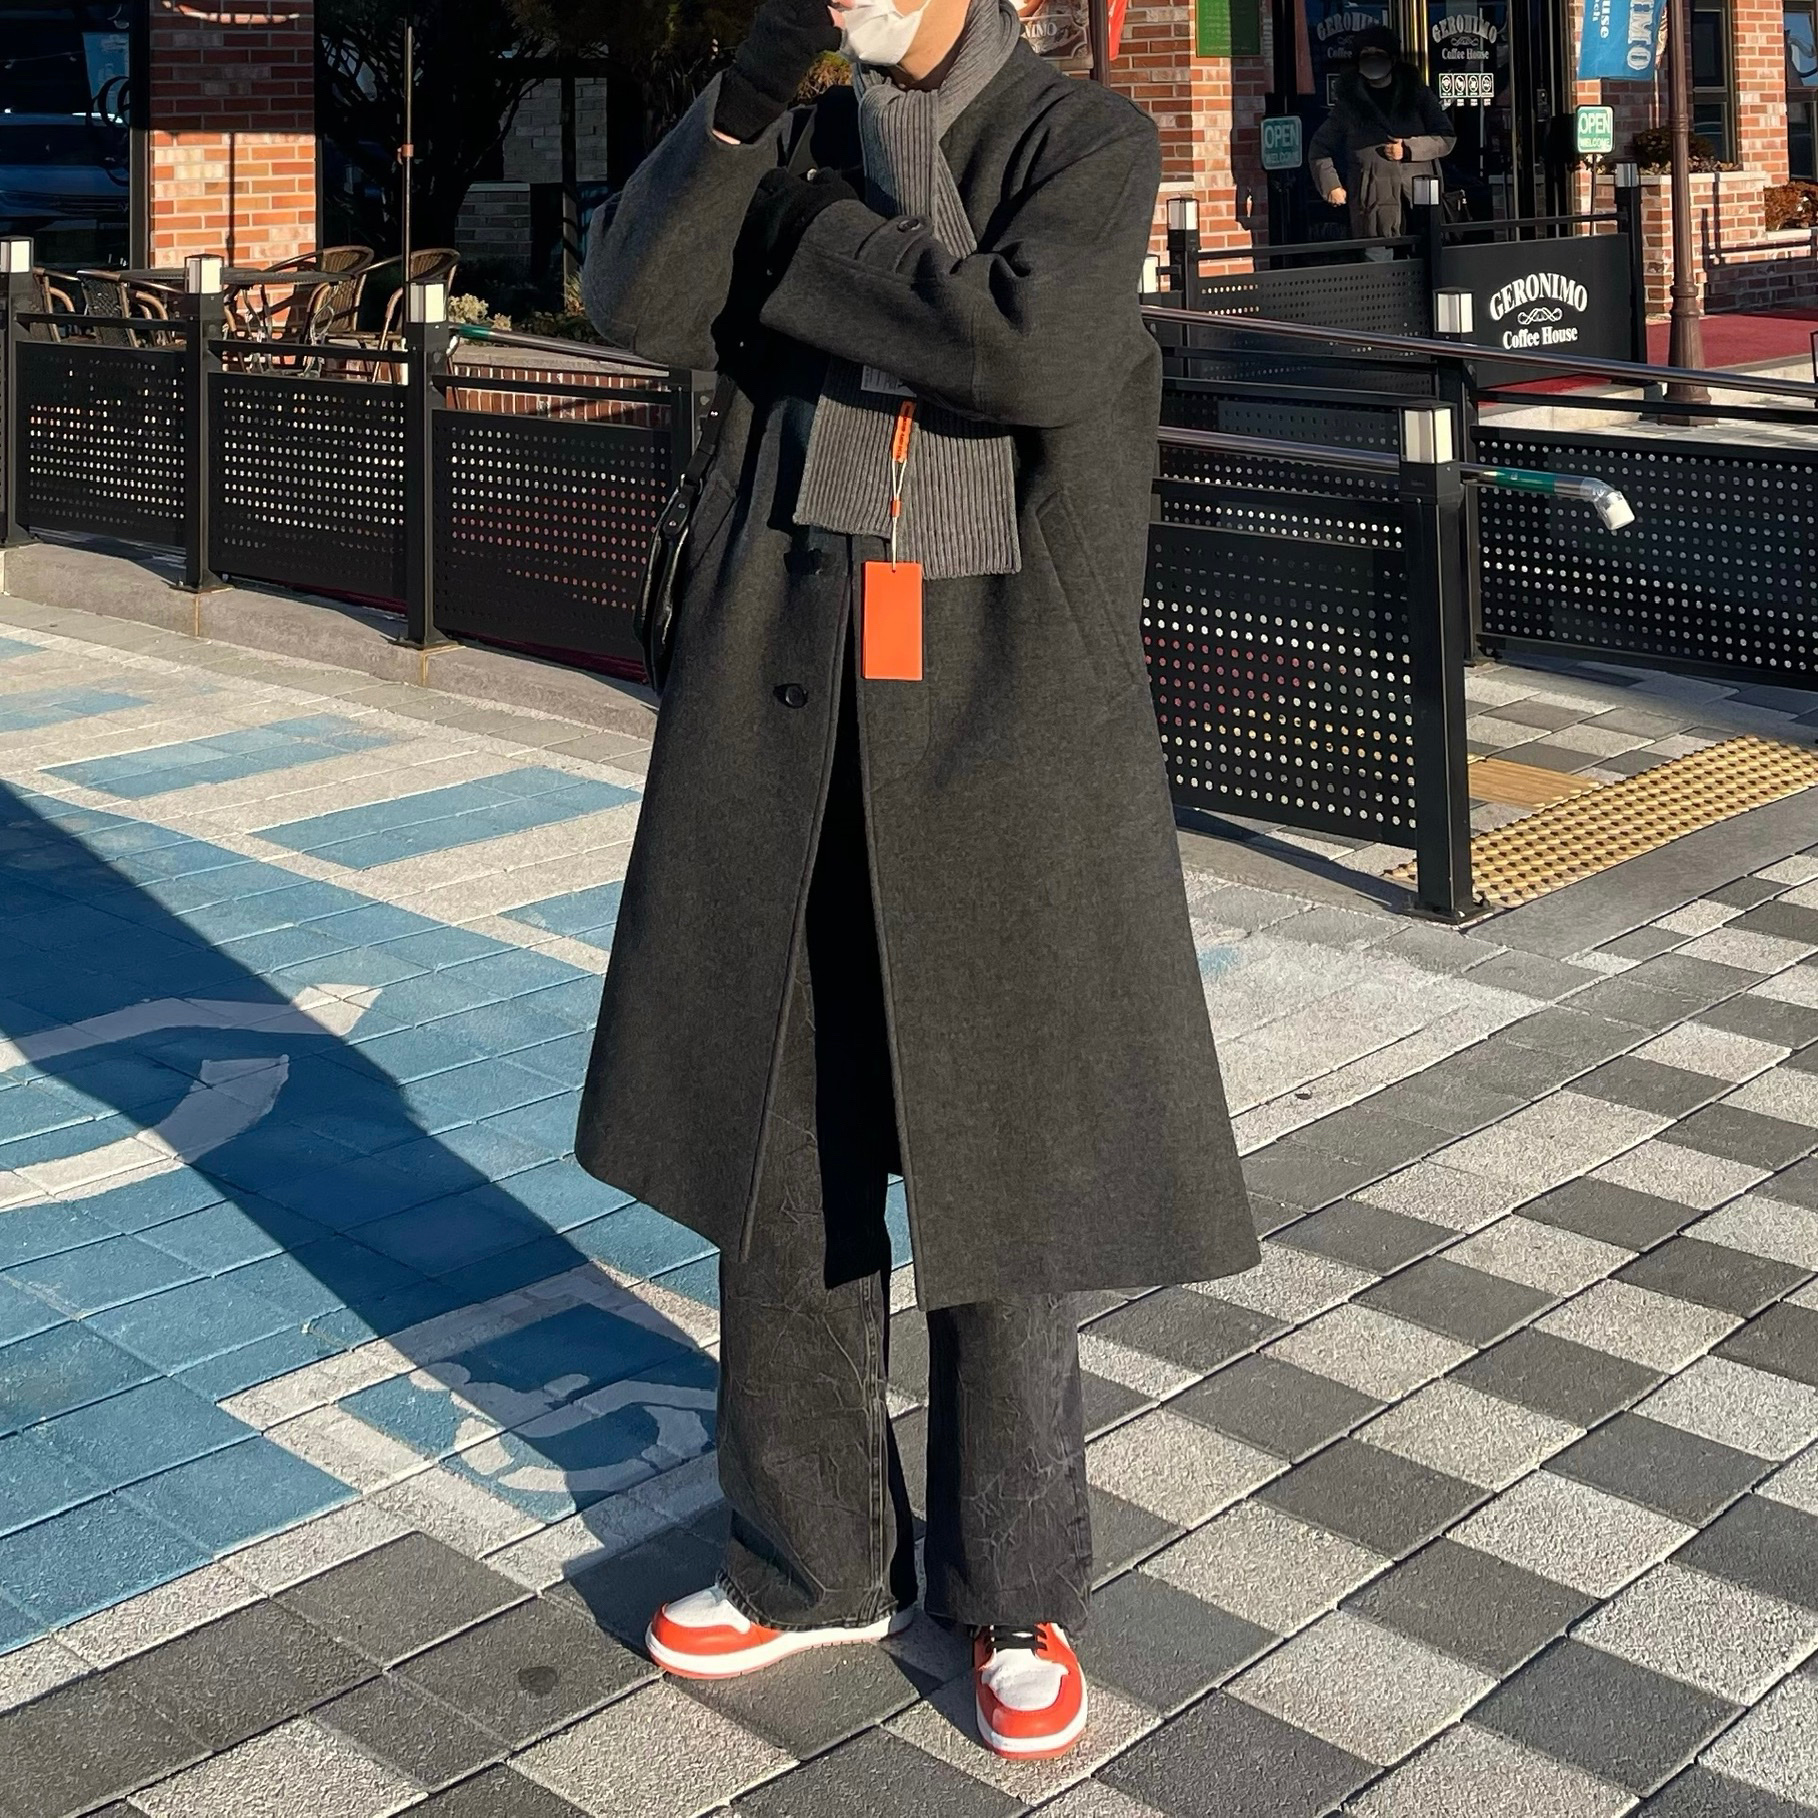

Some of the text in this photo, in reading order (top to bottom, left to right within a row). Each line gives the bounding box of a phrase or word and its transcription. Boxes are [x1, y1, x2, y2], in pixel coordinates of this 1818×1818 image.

[1432, 14, 1498, 44] GERONIMO
[1441, 47, 1490, 60] Coffee House
[1580, 112, 1612, 134] OPEN
[1265, 124, 1300, 149] OPEN
[1489, 271, 1588, 321] GERONIMO
[1502, 326, 1578, 350] Coffee House
